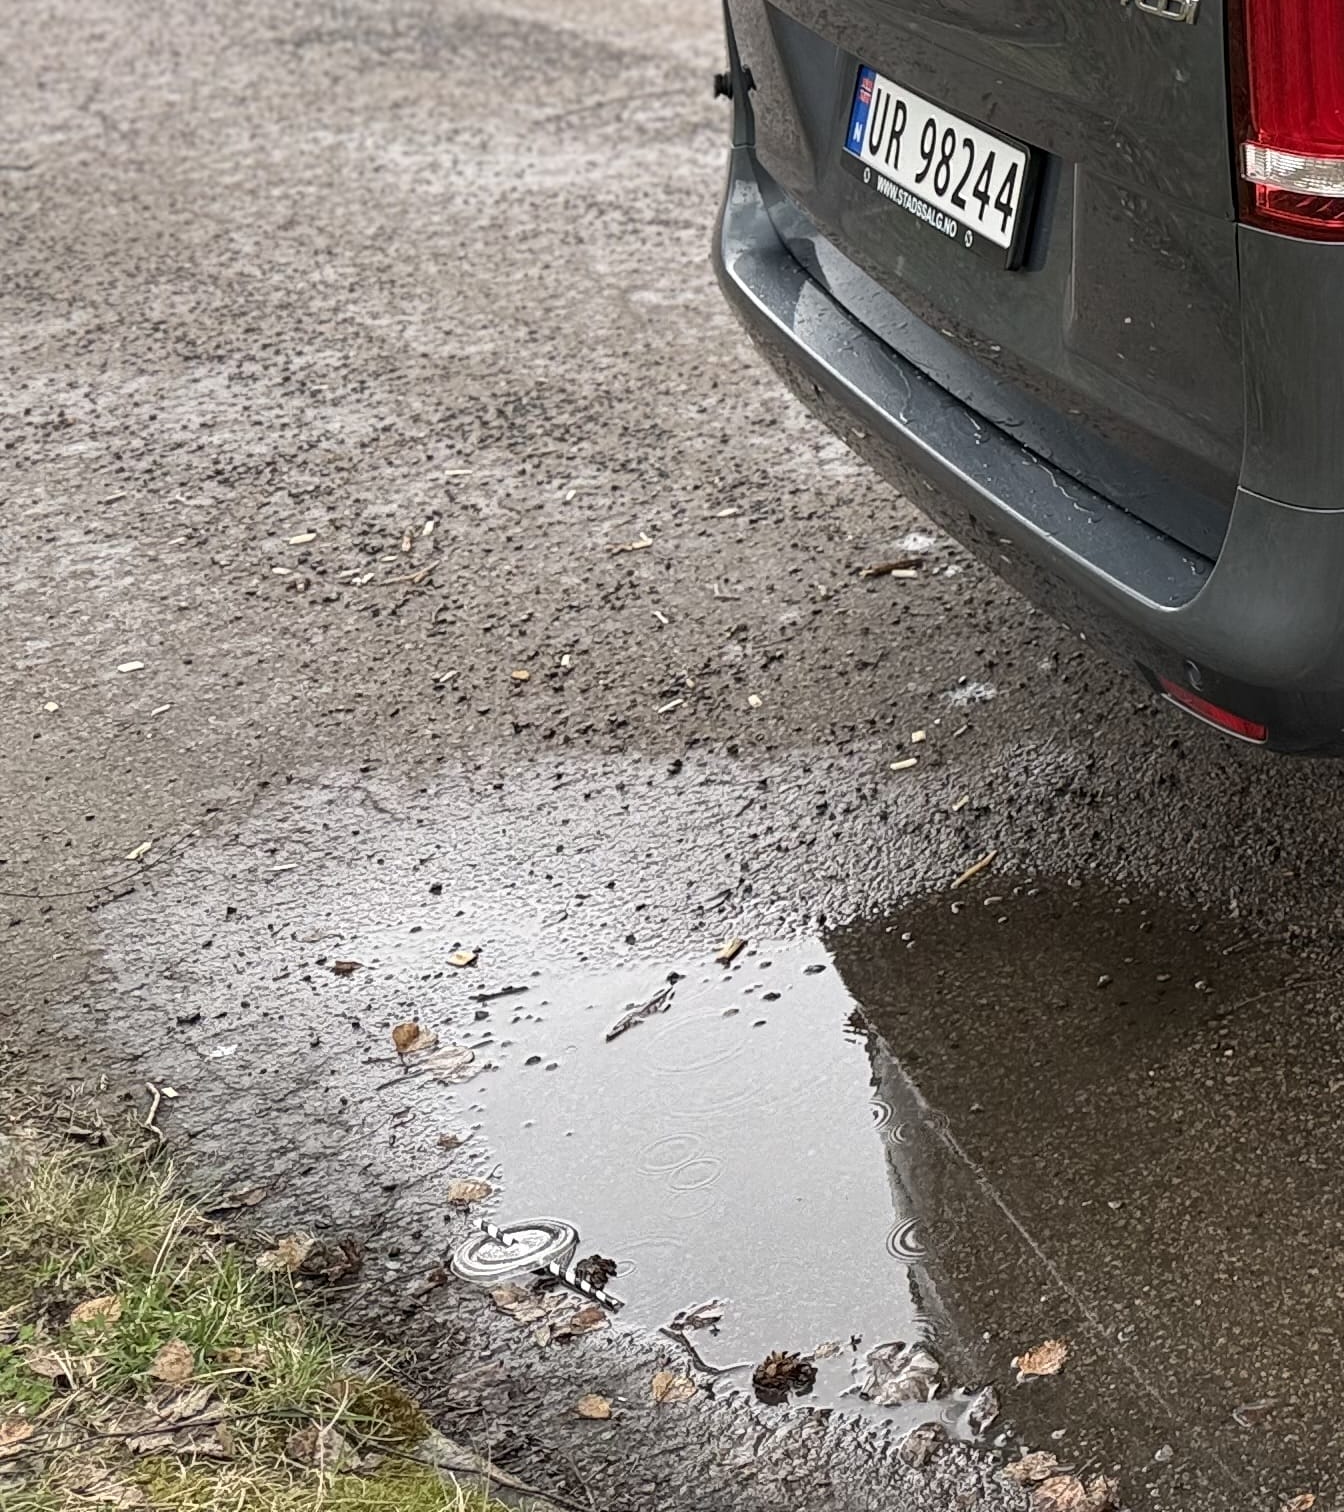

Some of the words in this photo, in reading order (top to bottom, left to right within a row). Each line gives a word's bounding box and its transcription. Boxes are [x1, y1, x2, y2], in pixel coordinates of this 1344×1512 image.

[853, 121, 863, 143] N
[868, 88, 907, 171] UR
[915, 117, 1018, 235] 98244
[876, 175, 957, 238] WWW.STADSSALG.NO
